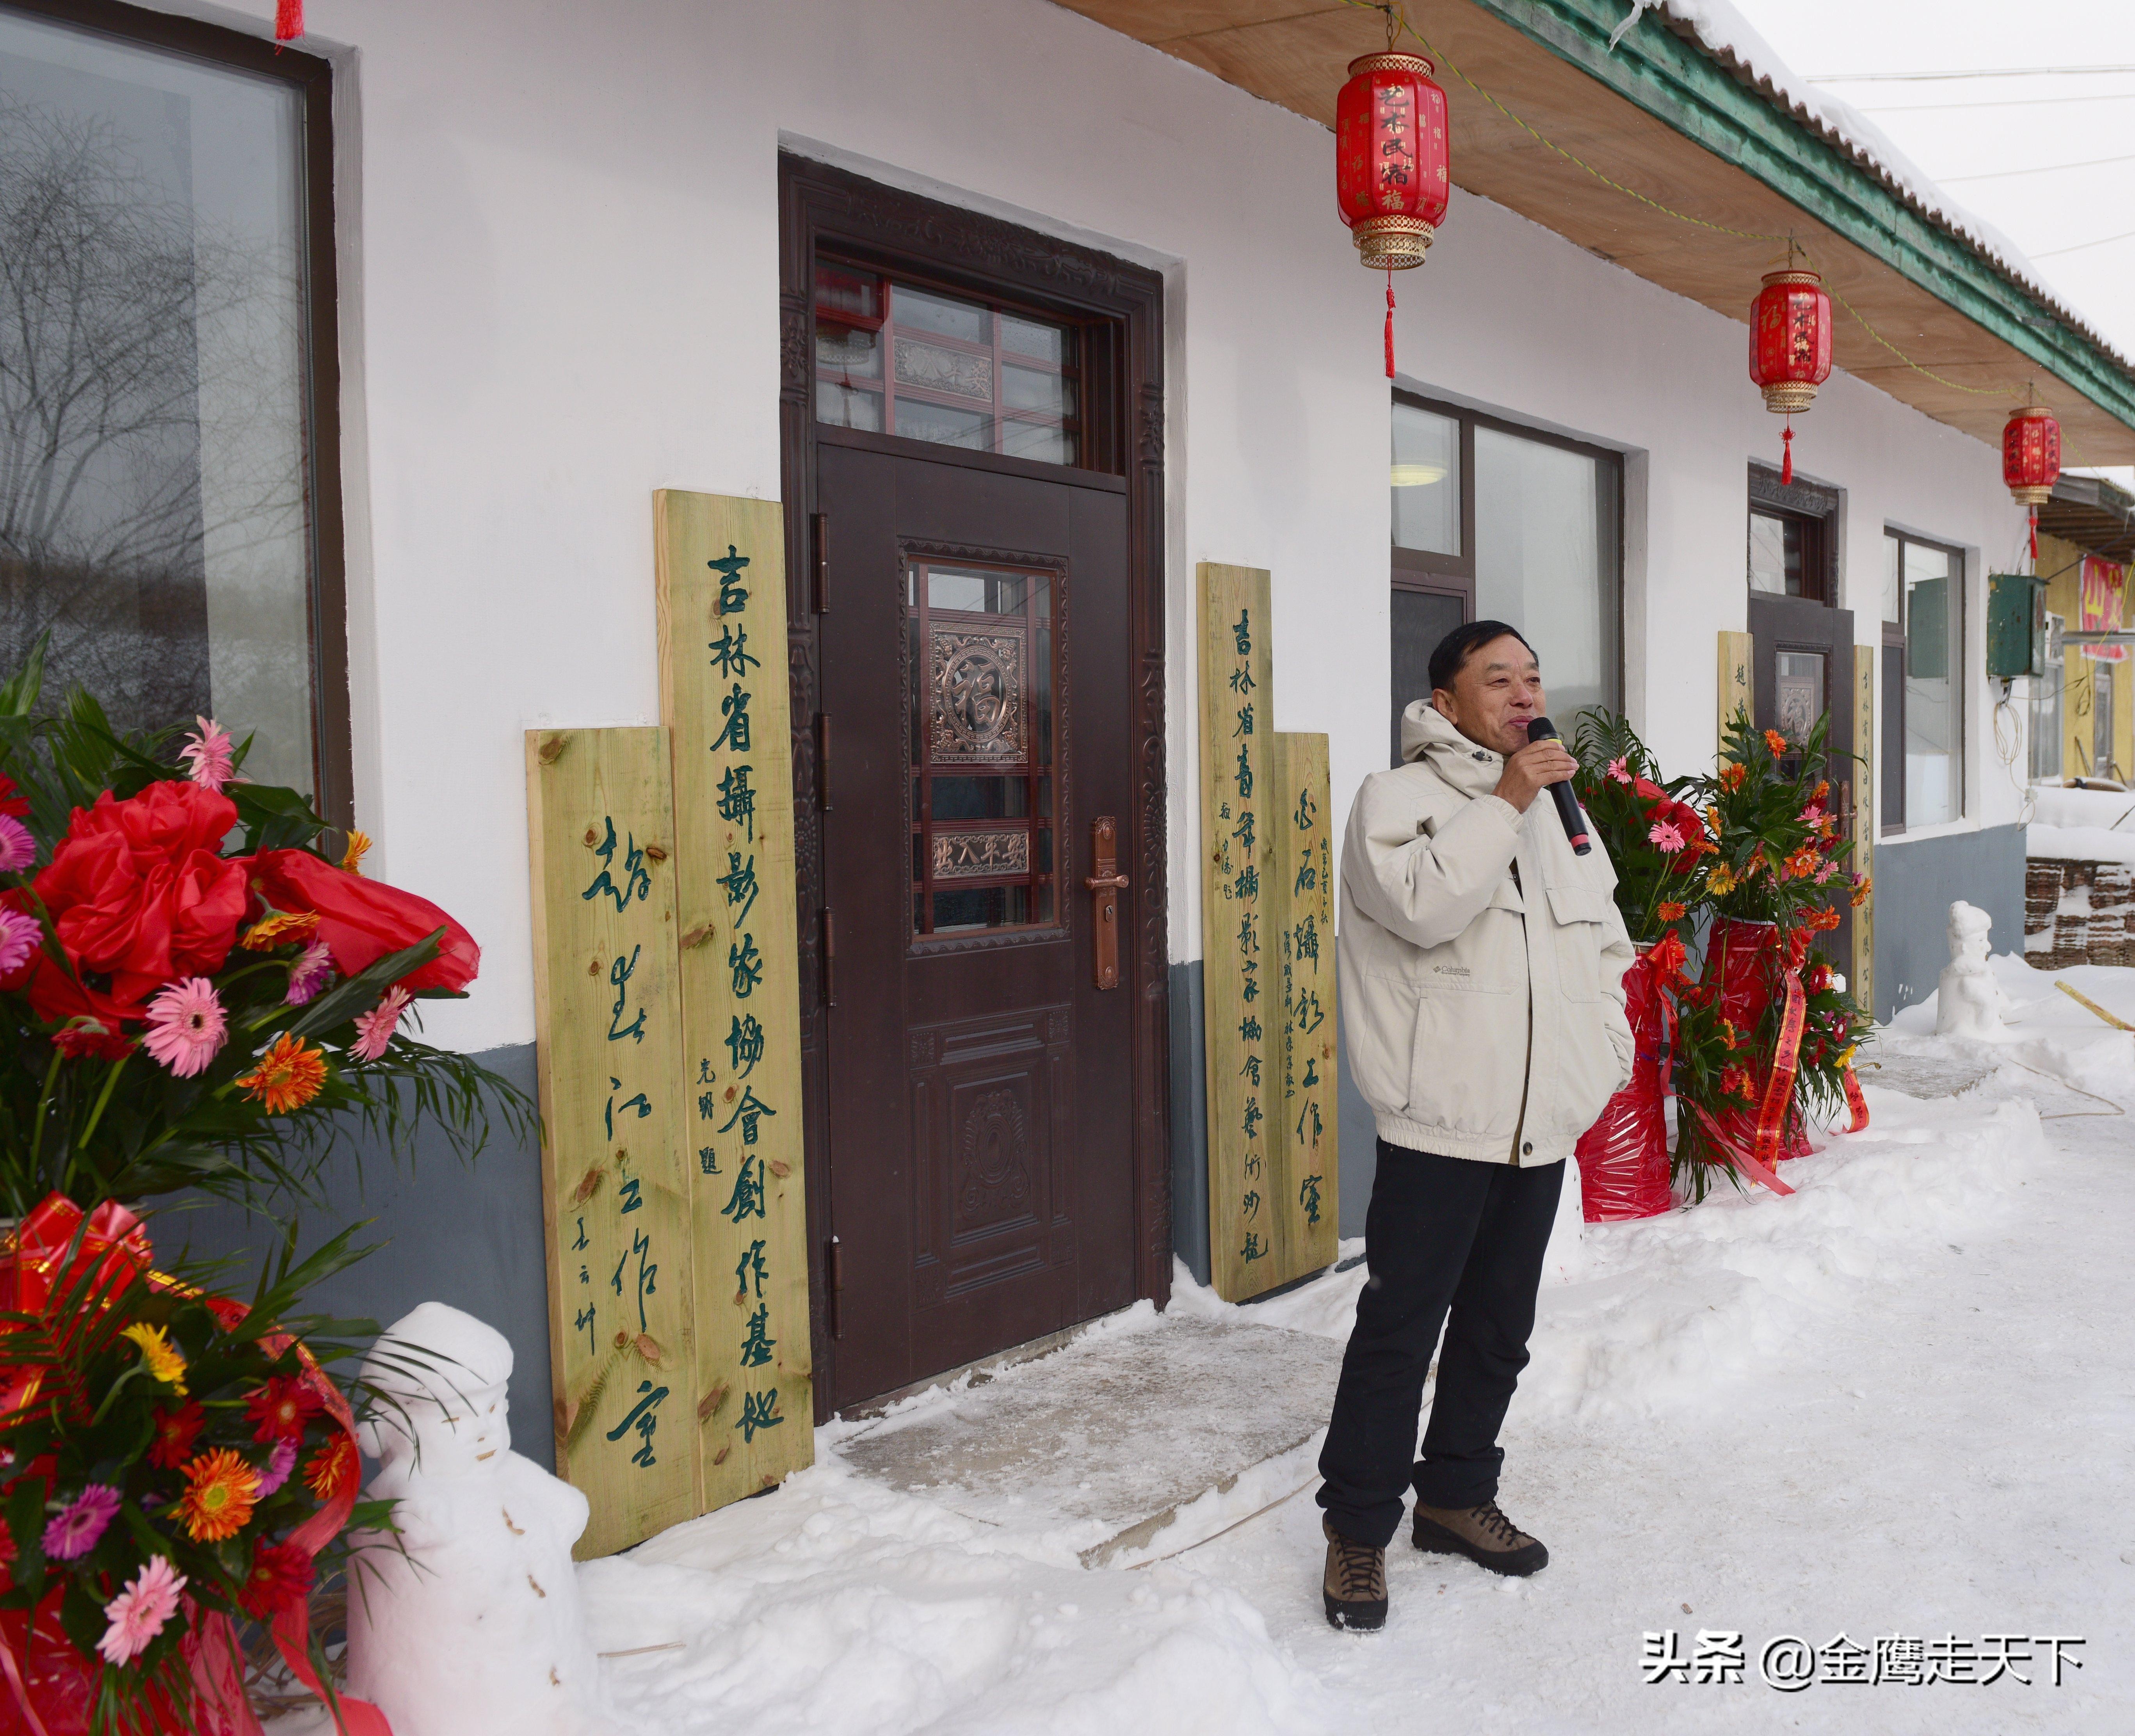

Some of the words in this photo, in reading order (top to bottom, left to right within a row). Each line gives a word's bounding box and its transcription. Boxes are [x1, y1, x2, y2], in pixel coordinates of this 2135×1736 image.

[1378, 87, 1413, 185] 艺术民宿
[951, 660, 1000, 727] 福
